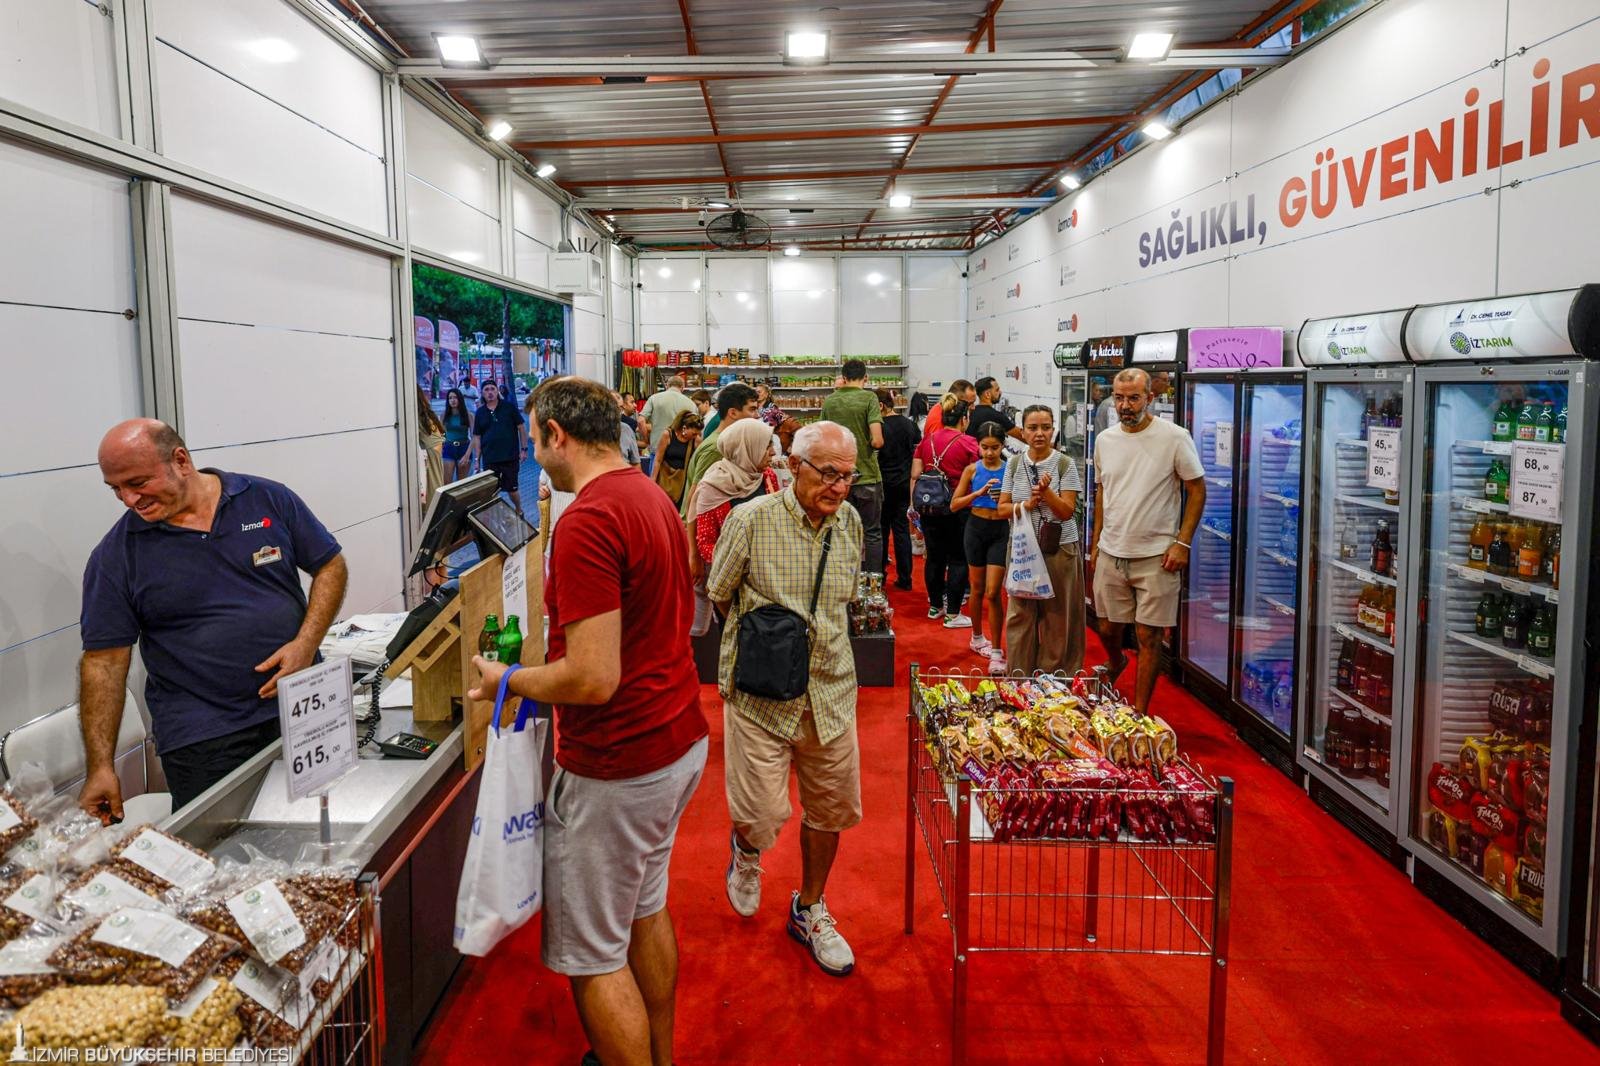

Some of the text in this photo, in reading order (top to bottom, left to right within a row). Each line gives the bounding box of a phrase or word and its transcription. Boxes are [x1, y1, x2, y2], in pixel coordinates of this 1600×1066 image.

[1139, 58, 1600, 268] SAĞLIKLI, GÜVENİLİR
[1089, 344, 1098, 361] by
[1524, 458, 1540, 472] 68,
[1522, 491, 1539, 506] 87,
[291, 693, 337, 718] 475, 00
[293, 745, 330, 775] 615,
